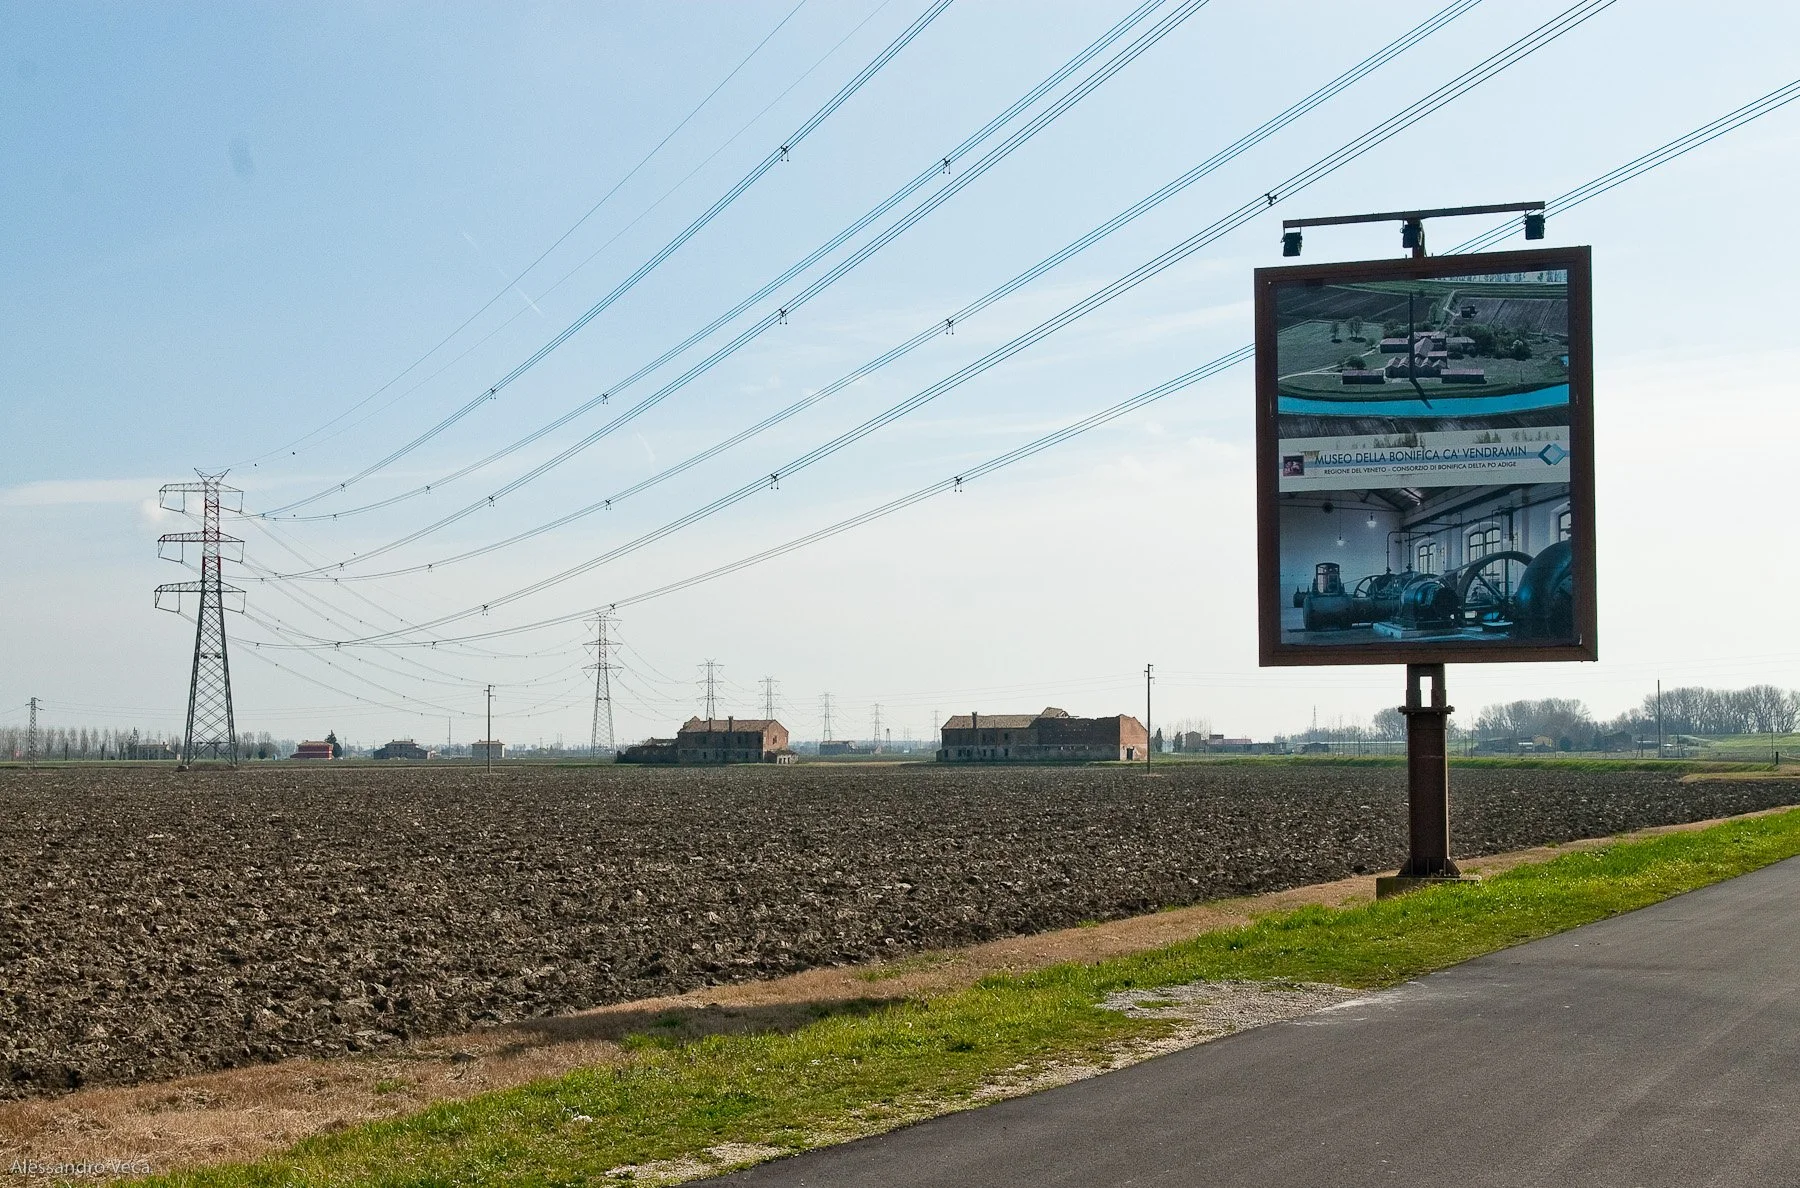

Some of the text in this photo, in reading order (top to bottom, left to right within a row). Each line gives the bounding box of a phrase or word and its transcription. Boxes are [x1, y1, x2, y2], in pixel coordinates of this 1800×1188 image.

[1315, 446, 1527, 465] MUSEO DELLA BONIFICA CA' VENDRAMIN
[1392, 464, 1428, 472] CONSORZIO
[1438, 463, 1466, 471] BONIFICA
